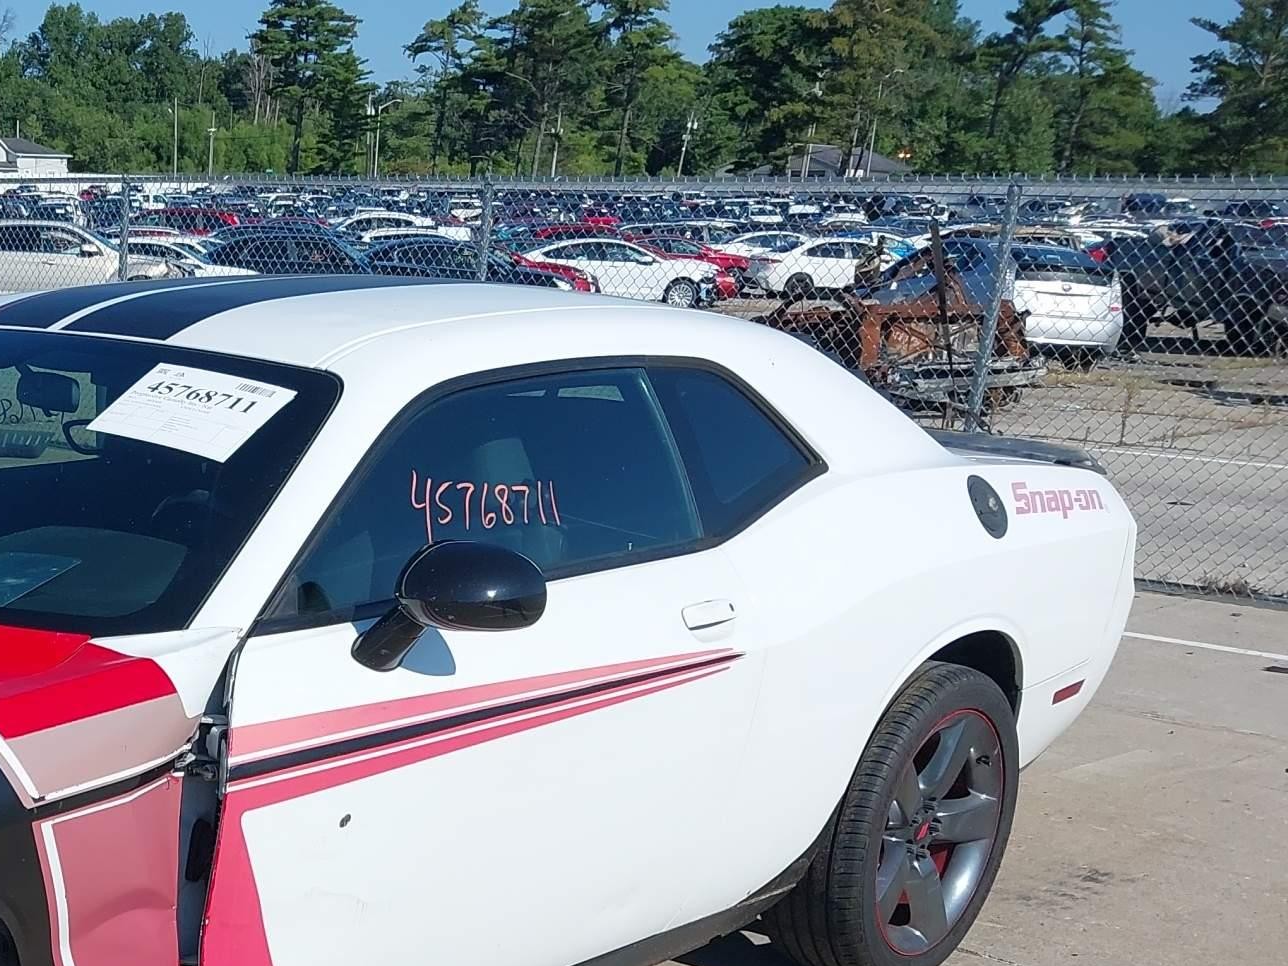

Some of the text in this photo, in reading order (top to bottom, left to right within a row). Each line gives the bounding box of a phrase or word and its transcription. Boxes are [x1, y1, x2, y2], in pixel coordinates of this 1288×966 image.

[146, 380, 258, 414] 45768711
[410, 469, 561, 544] 45768711
[1011, 481, 1104, 519] Snap-on
